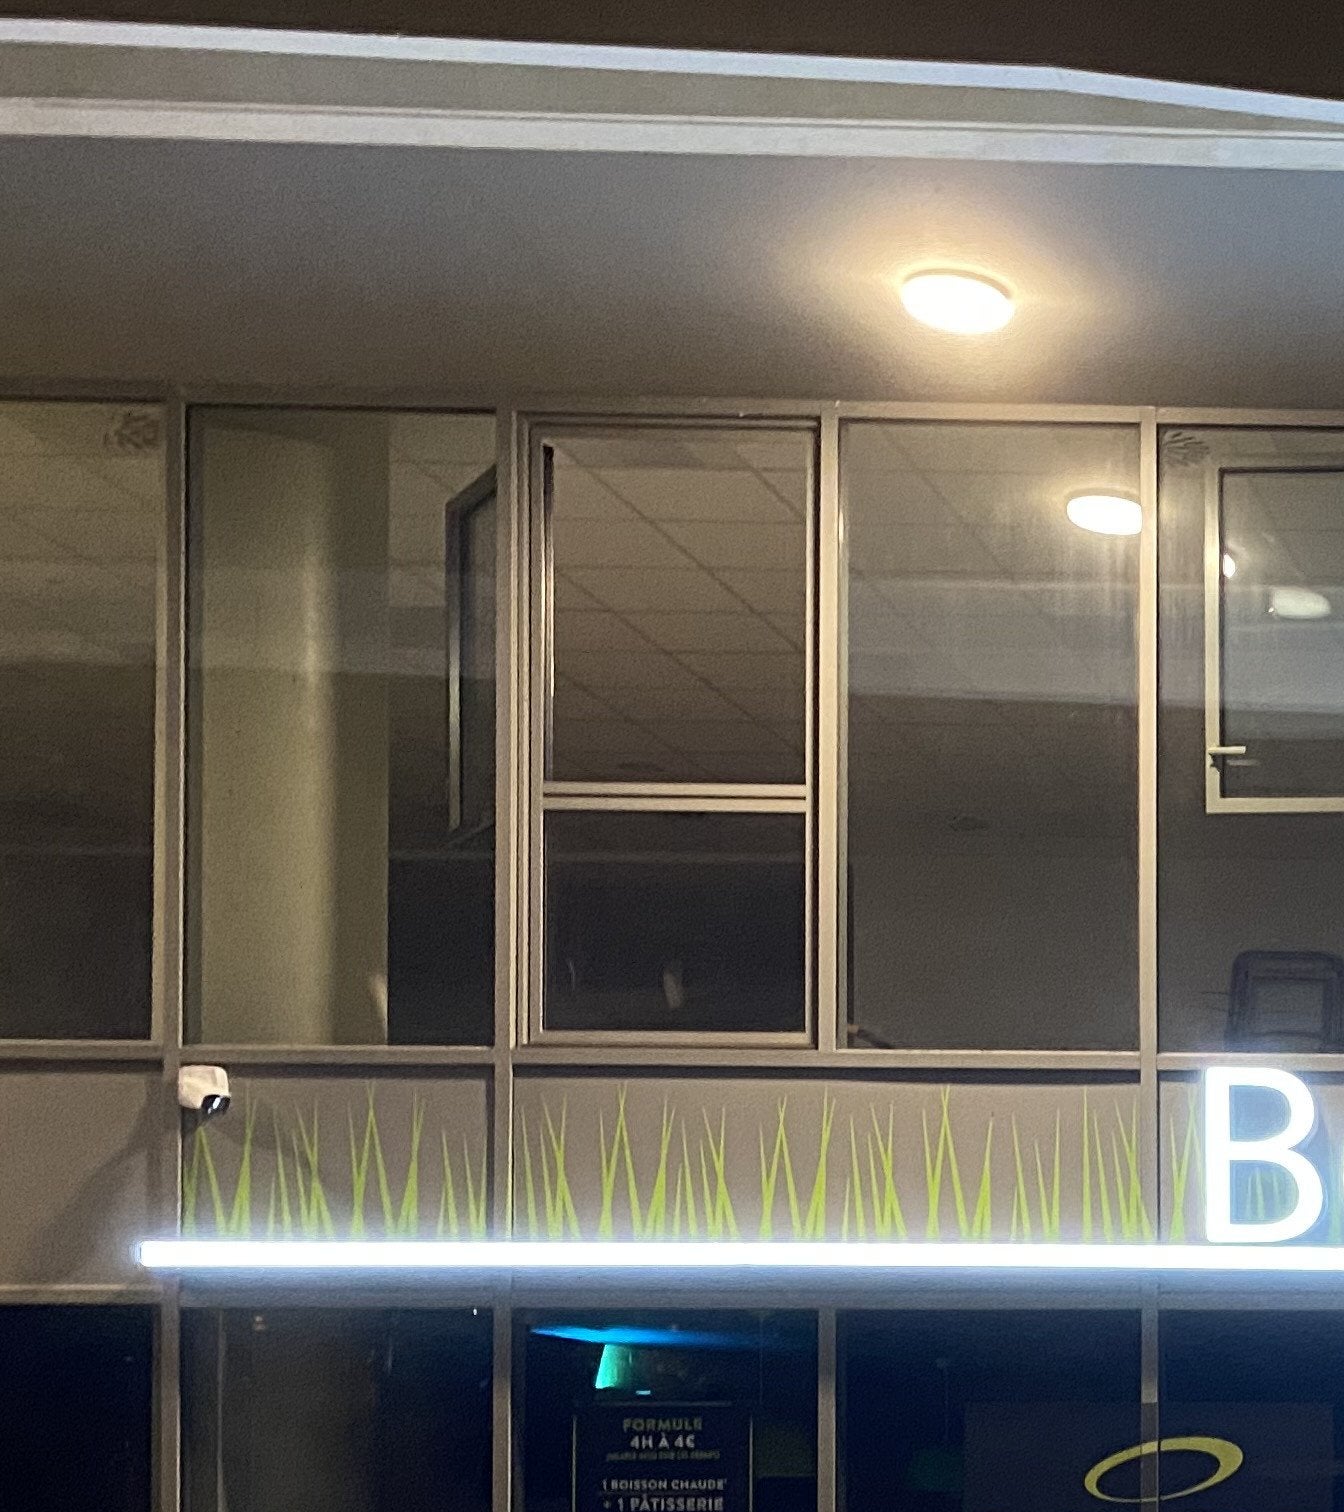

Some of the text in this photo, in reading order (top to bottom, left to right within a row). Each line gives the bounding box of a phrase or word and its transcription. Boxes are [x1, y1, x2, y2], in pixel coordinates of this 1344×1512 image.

[623, 1417, 703, 1432] FORMULE
[630, 1432, 695, 1449] 4H À 4€
[611, 1479, 668, 1490] BOISSON
[630, 1494, 723, 1512] PÂTISSERIE
